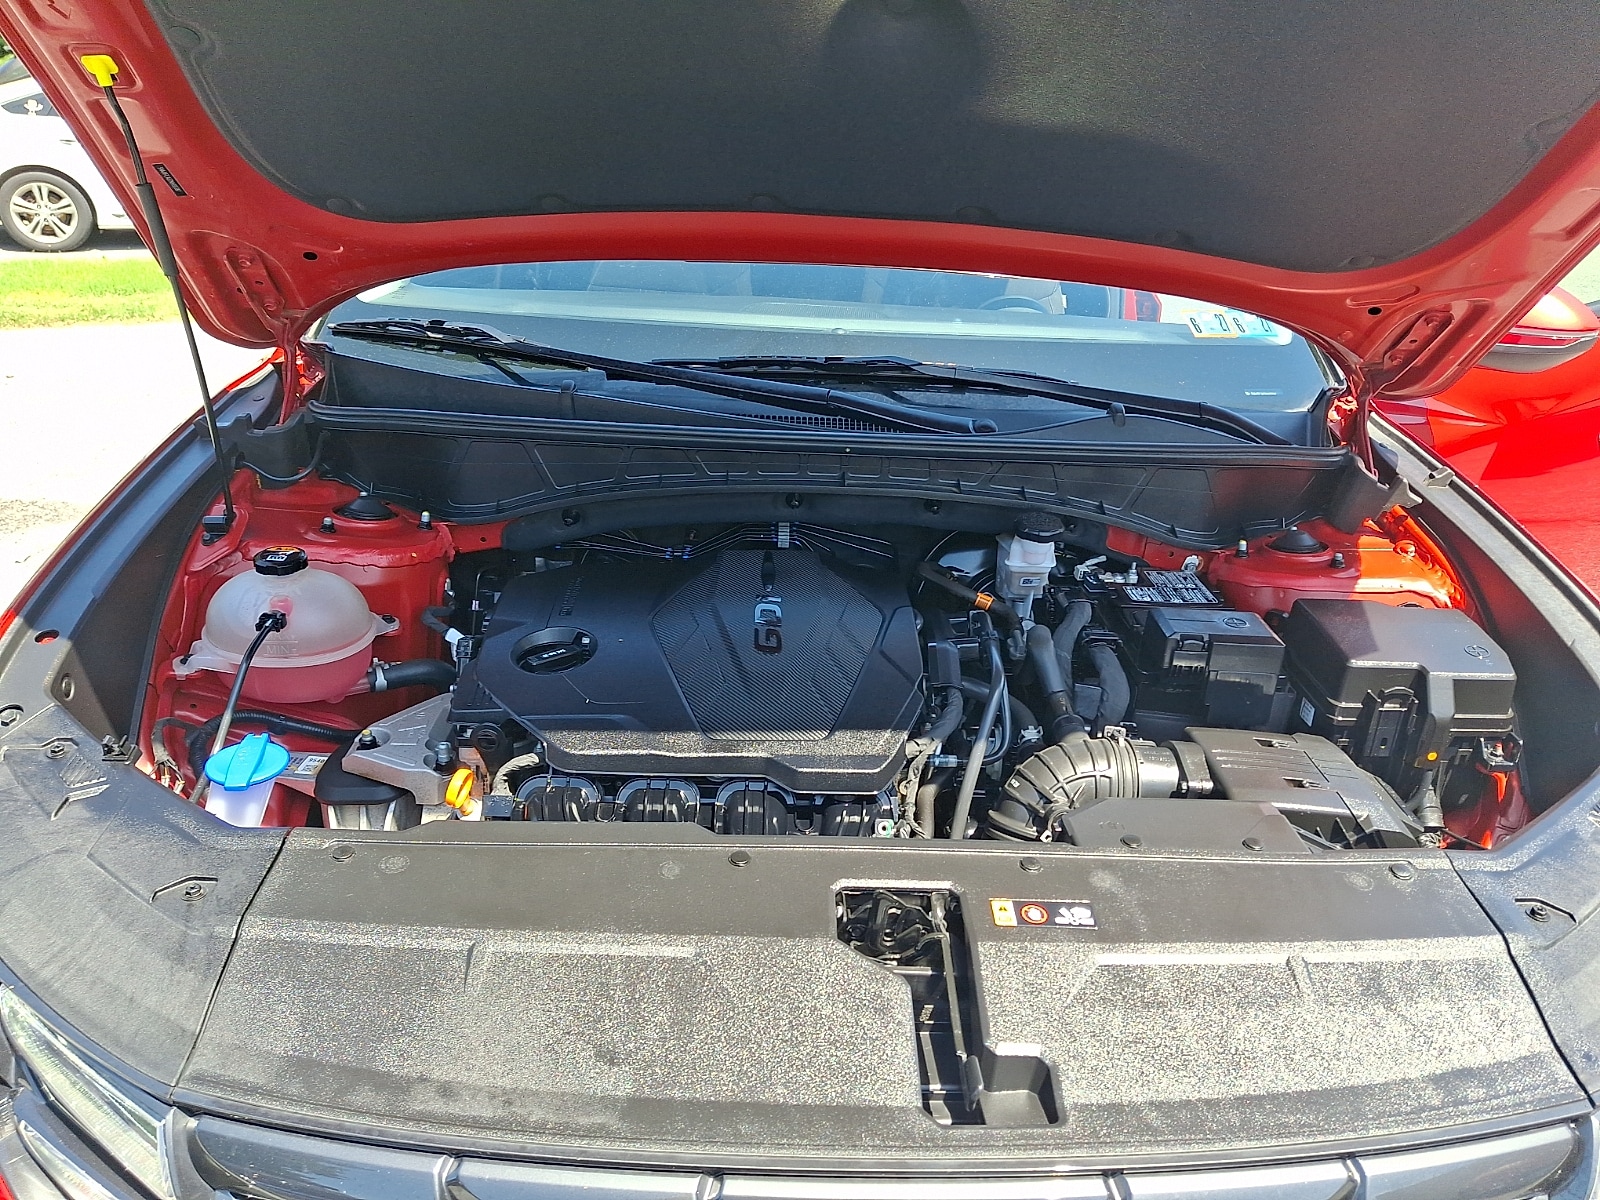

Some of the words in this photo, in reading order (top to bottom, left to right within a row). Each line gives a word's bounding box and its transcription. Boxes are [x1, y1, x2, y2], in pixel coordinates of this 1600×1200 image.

[1189, 317, 1202, 334] 6
[1214, 313, 1231, 333] 27
[1232, 317, 1246, 333] 6
[266, 645, 290, 654] MIN
